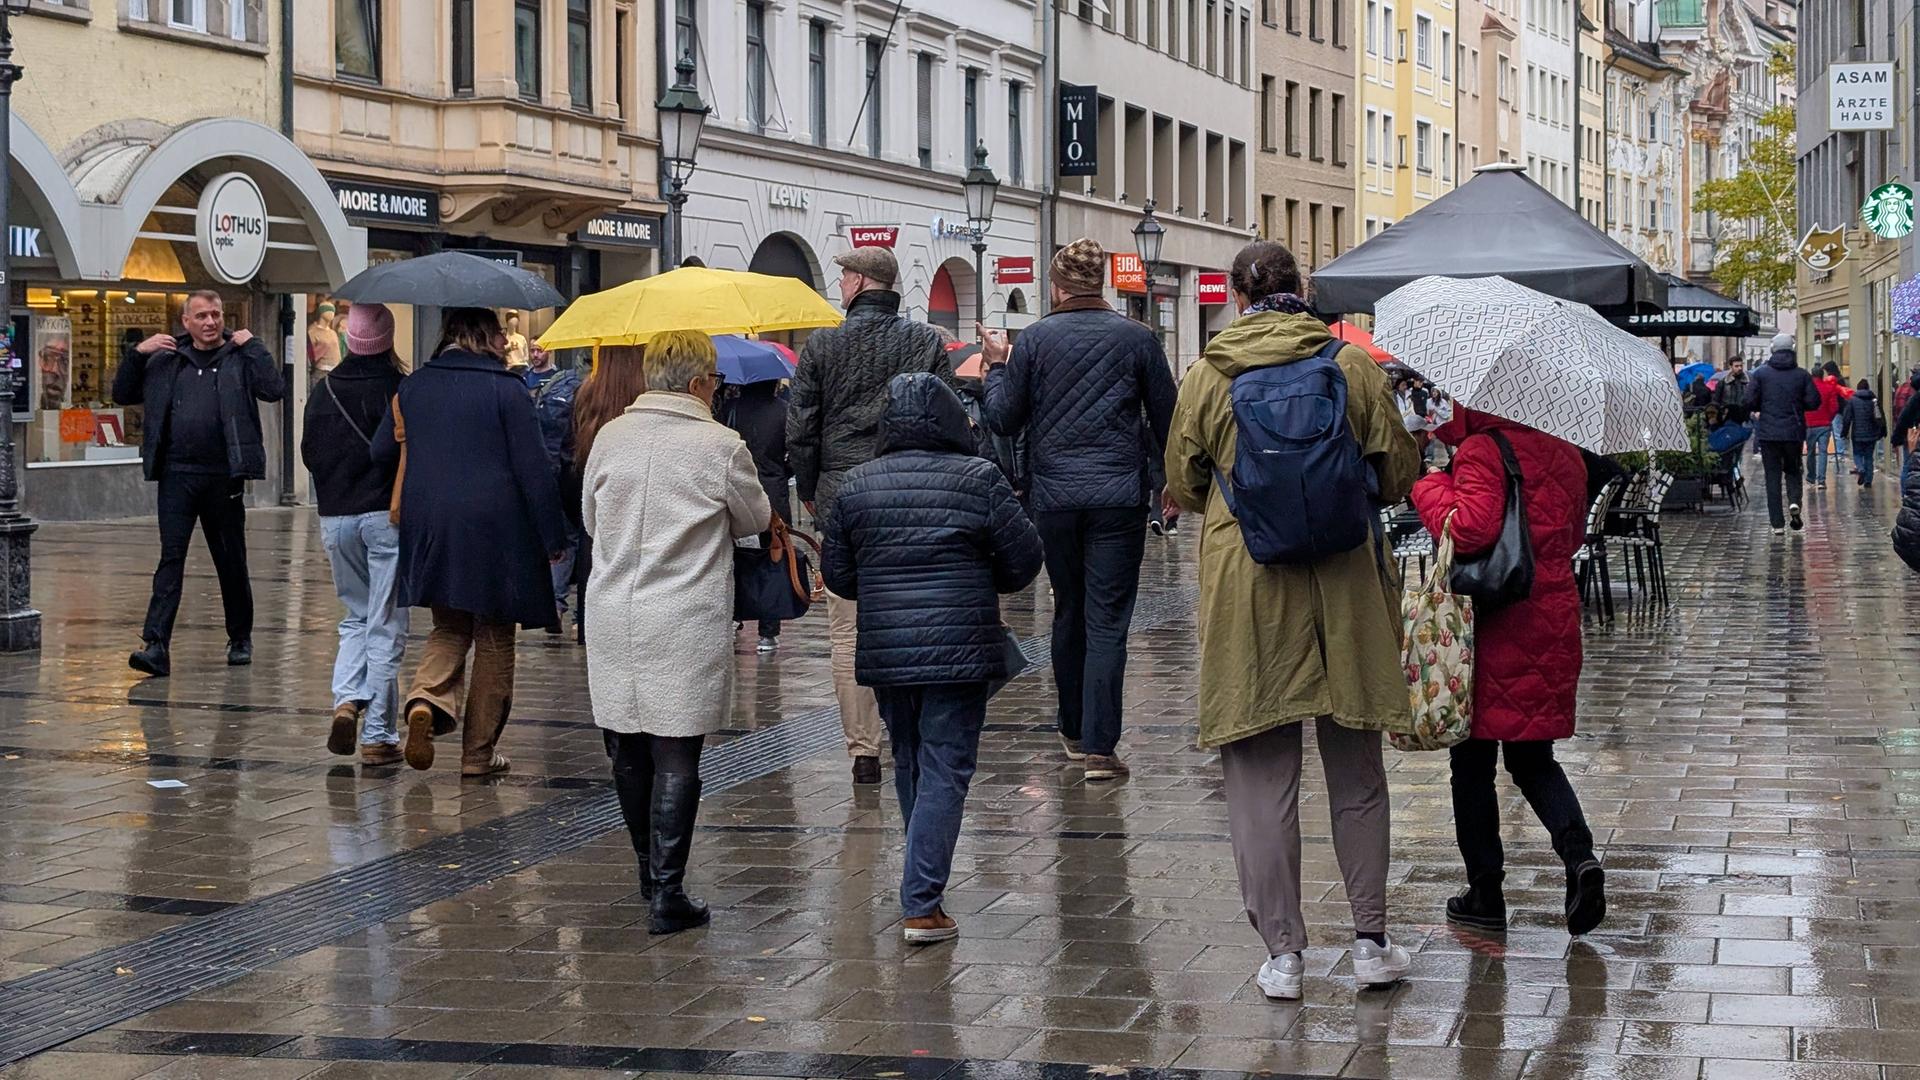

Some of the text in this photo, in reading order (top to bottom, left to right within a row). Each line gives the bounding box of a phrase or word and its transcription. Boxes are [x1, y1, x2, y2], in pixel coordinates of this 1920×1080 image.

[1836, 71, 1887, 84] ASAM
[1836, 97, 1887, 108] ÄRZTE
[1841, 111, 1883, 121] HAUS
[1067, 102, 1083, 160] MIO
[339, 189, 427, 217] MORE & MORE
[216, 214, 262, 235] LOTHUS
[587, 218, 651, 240] MORE & MORE
[946, 224, 954, 234] LE
[215, 234, 234, 251] optic
[1117, 256, 1142, 273] JBL
[1117, 274, 1143, 283] STORE
[1200, 284, 1226, 293] REWE
